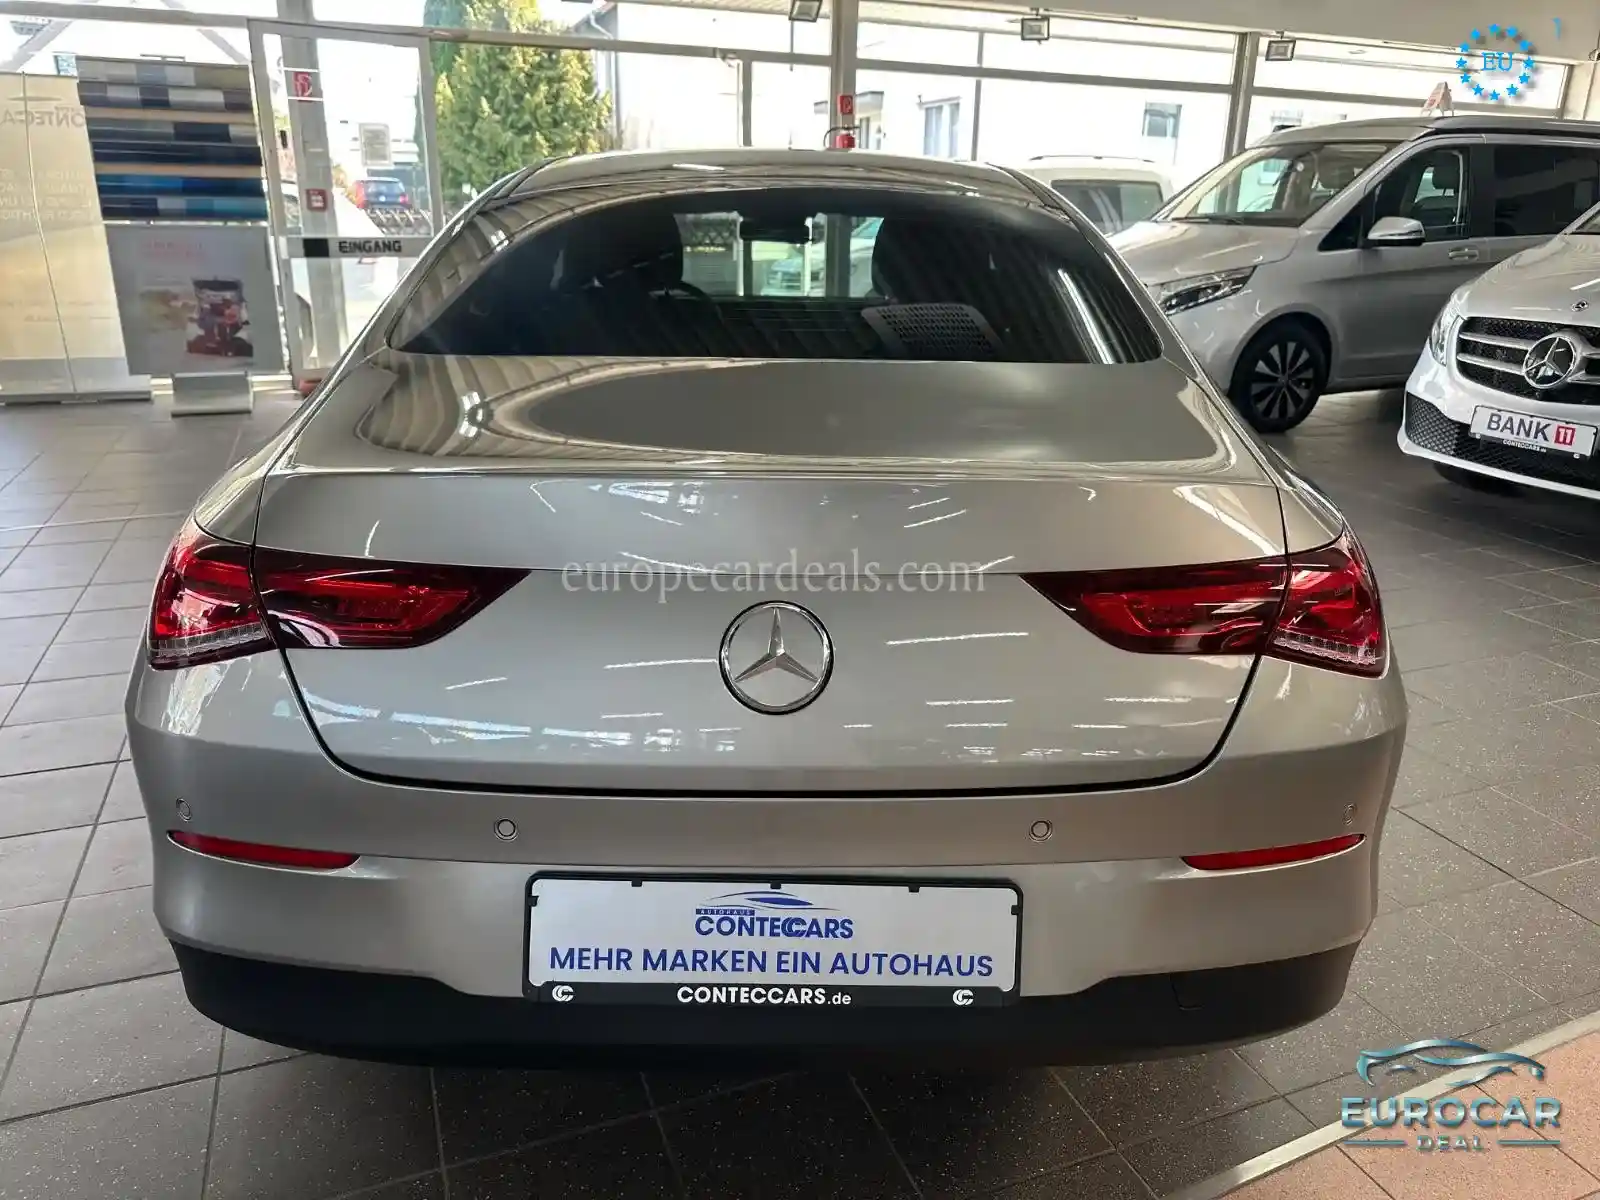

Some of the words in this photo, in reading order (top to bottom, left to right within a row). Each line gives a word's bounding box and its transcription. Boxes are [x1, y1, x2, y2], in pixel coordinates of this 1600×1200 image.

[338, 239, 402, 254] EINGANG
[1487, 413, 1551, 441] BANK
[695, 915, 853, 939] CONTECCARS
[550, 947, 632, 970] MEHR
[642, 949, 767, 972] MARKEN
[776, 951, 820, 973] EIN
[829, 952, 993, 976] AUTOHAUS
[677, 986, 851, 1005] CONTECCARS.de
